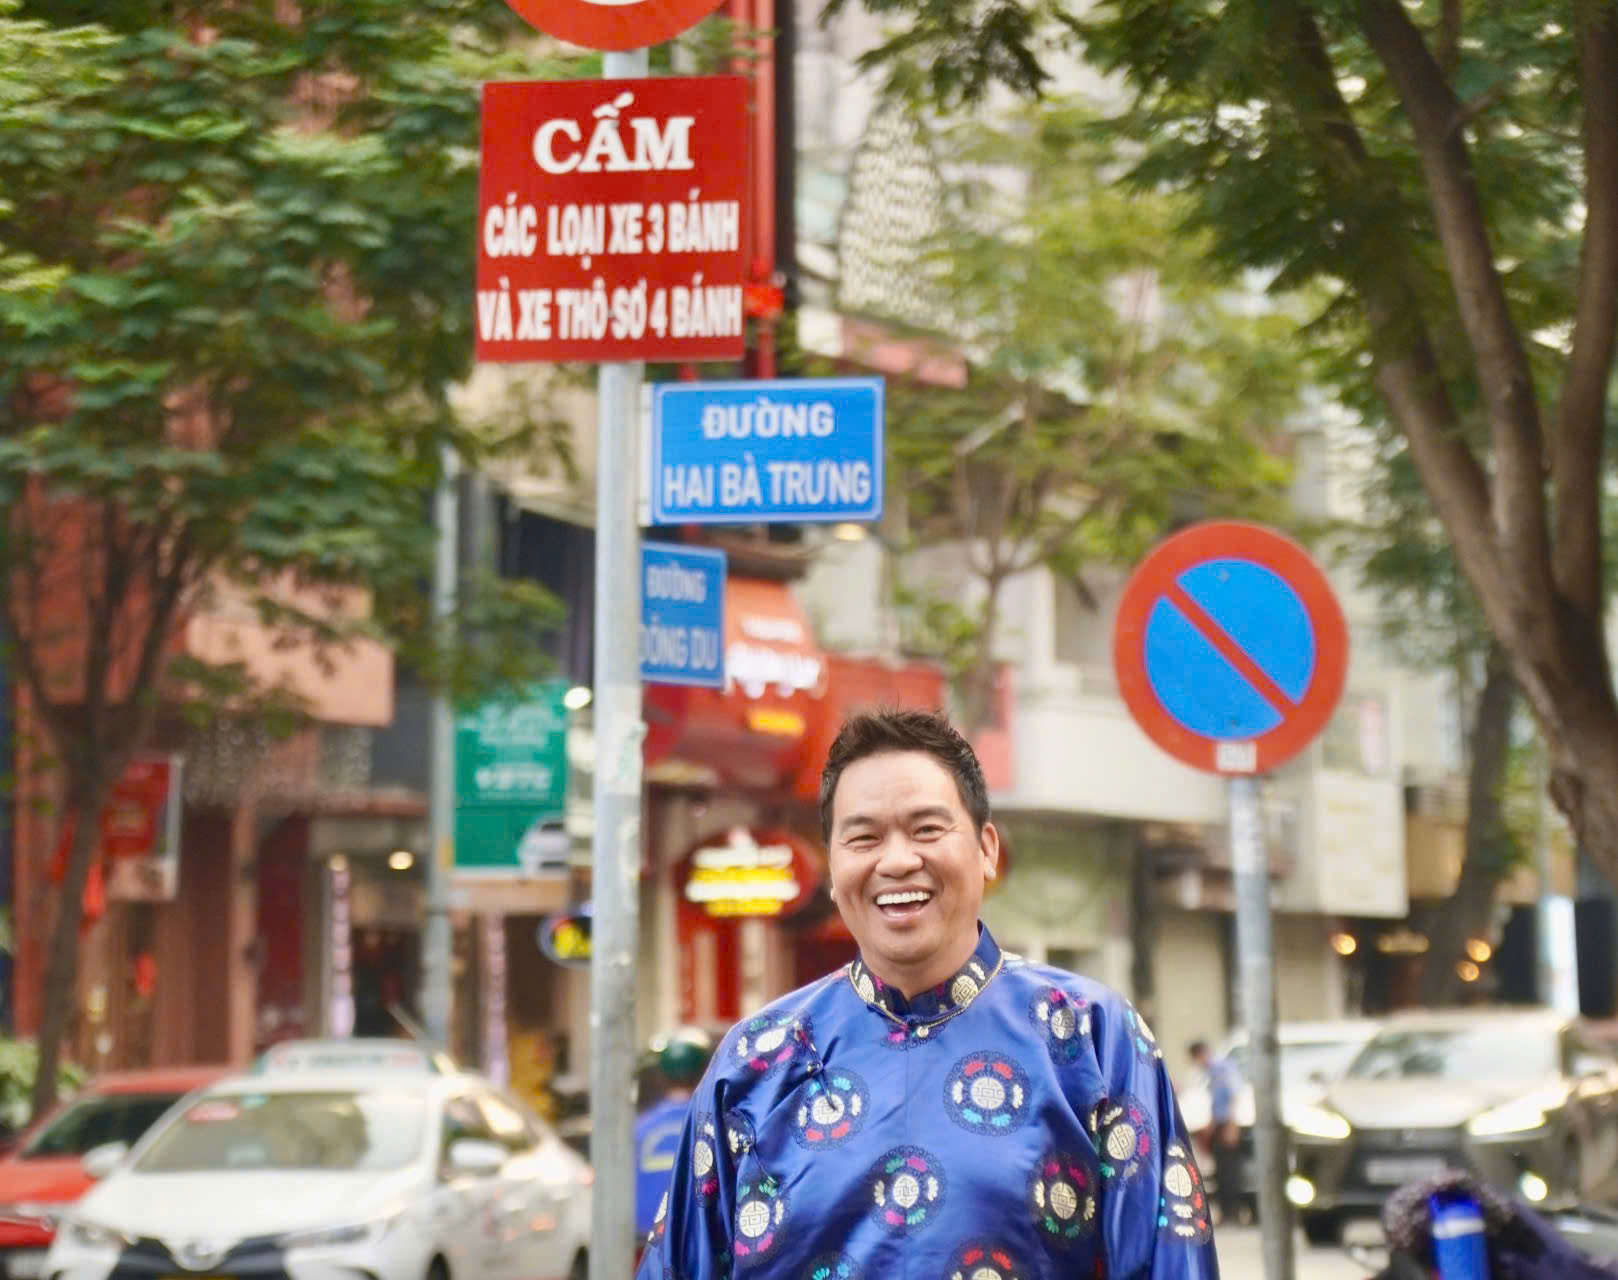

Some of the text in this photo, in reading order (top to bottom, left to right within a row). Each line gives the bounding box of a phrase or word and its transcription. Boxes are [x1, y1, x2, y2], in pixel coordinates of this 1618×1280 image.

[532, 91, 695, 174] CẤM
[484, 187, 740, 270] CÁC LOẠI XE 3 BÁNH
[477, 275, 514, 341] VÀ
[516, 288, 552, 341] XE
[555, 276, 608, 341] THÔ
[650, 288, 668, 339] 4
[671, 272, 743, 338] BÁNH
[702, 396, 835, 438] ĐƯỜNG
[663, 451, 871, 507] HAI BÀ TRƯNG
